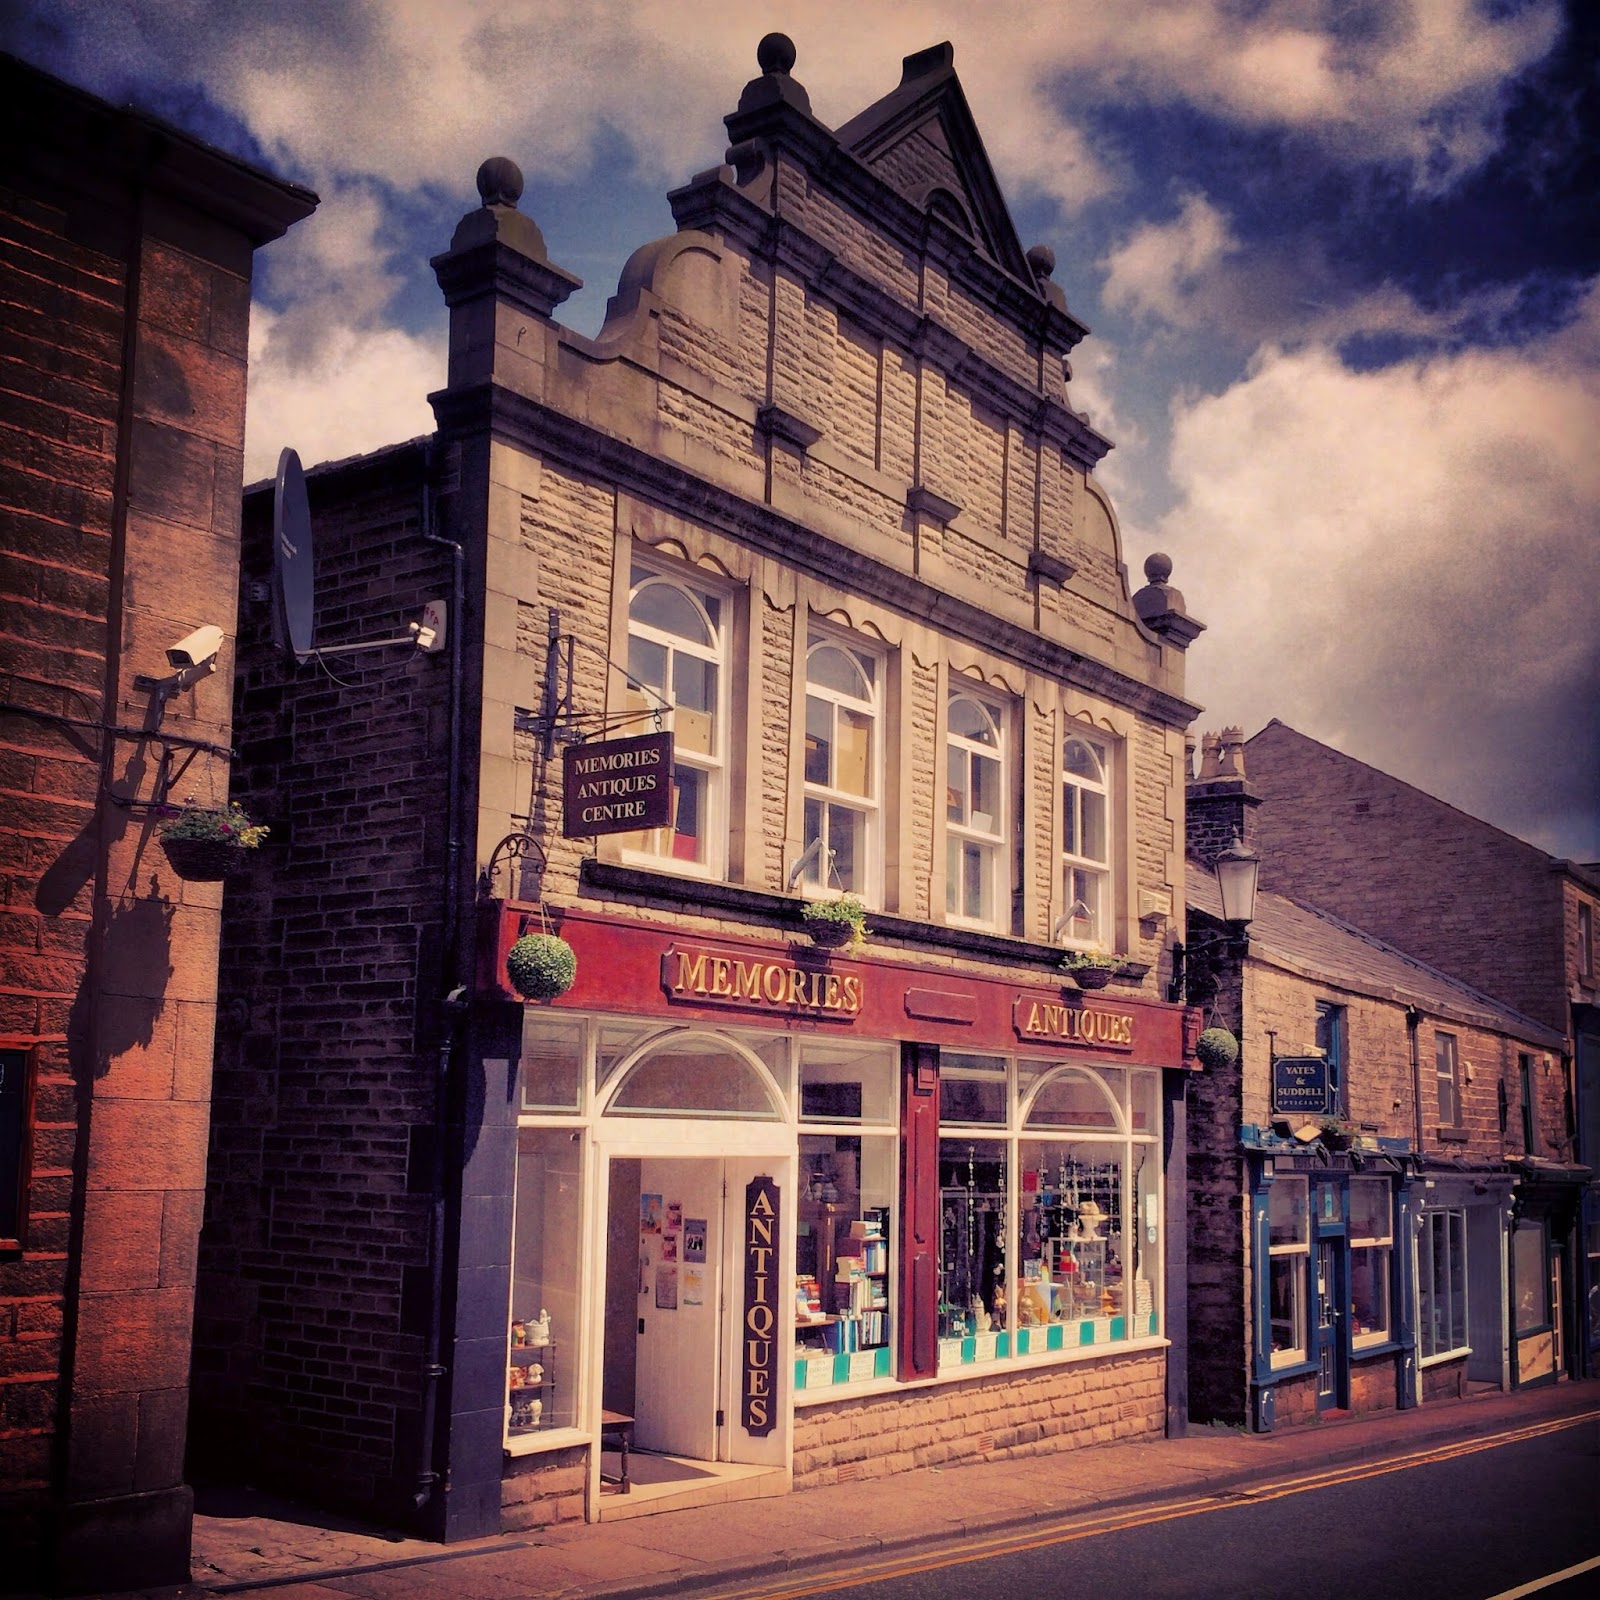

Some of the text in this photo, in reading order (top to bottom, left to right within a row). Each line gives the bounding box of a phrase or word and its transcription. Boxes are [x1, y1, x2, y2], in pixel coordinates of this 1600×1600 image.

[575, 748, 660, 775] MEMORIES
[577, 774, 657, 799] ANTIQUES
[582, 800, 646, 823] CENTRE
[674, 951, 860, 1012] MEMORIES
[1025, 1001, 1134, 1045] ANTIQUES
[1285, 1066, 1316, 1075] YATES
[1295, 1077, 1306, 1086] &
[1277, 1087, 1325, 1096] SUDDELL
[746, 1189, 775, 1427] ANTIQUES
